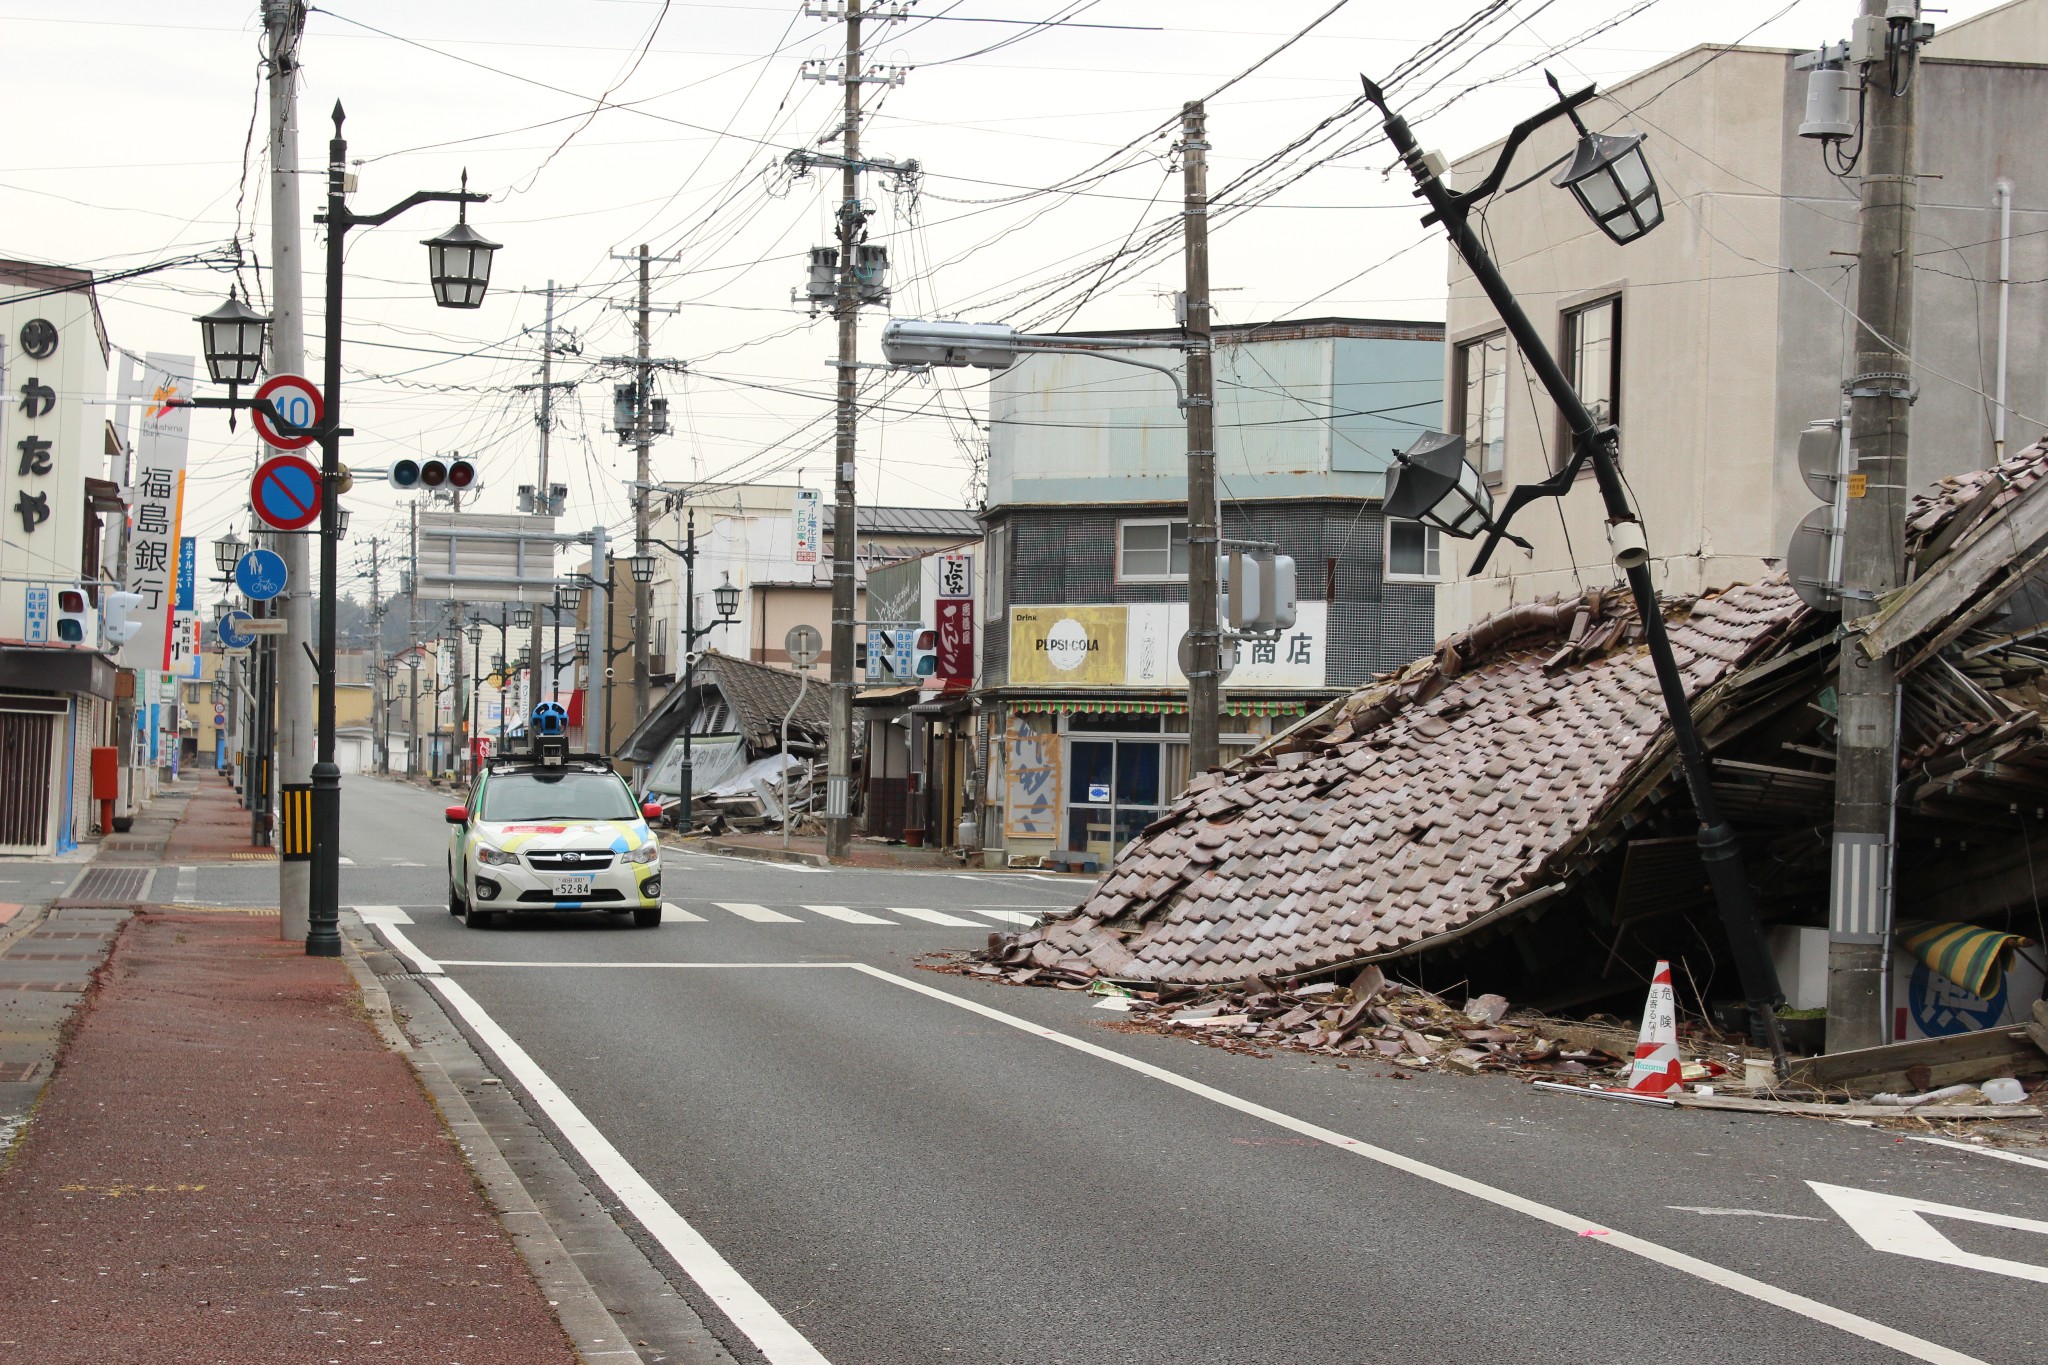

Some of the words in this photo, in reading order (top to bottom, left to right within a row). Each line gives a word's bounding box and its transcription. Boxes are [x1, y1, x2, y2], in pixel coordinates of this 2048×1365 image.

[142, 429, 161, 437] Bank
[143, 422, 183, 432] Fukushima
[14, 378, 57, 533] わたや
[131, 466, 173, 610] 福島銀行
[807, 500, 817, 551] オール電化住宅
[184, 540, 194, 588] ホテルニュー
[181, 616, 191, 654] 中国料理
[521, 685, 529, 719] クリーニング
[561, 884, 588, 894] 52-84
[1660, 987, 1672, 1028] 危険
